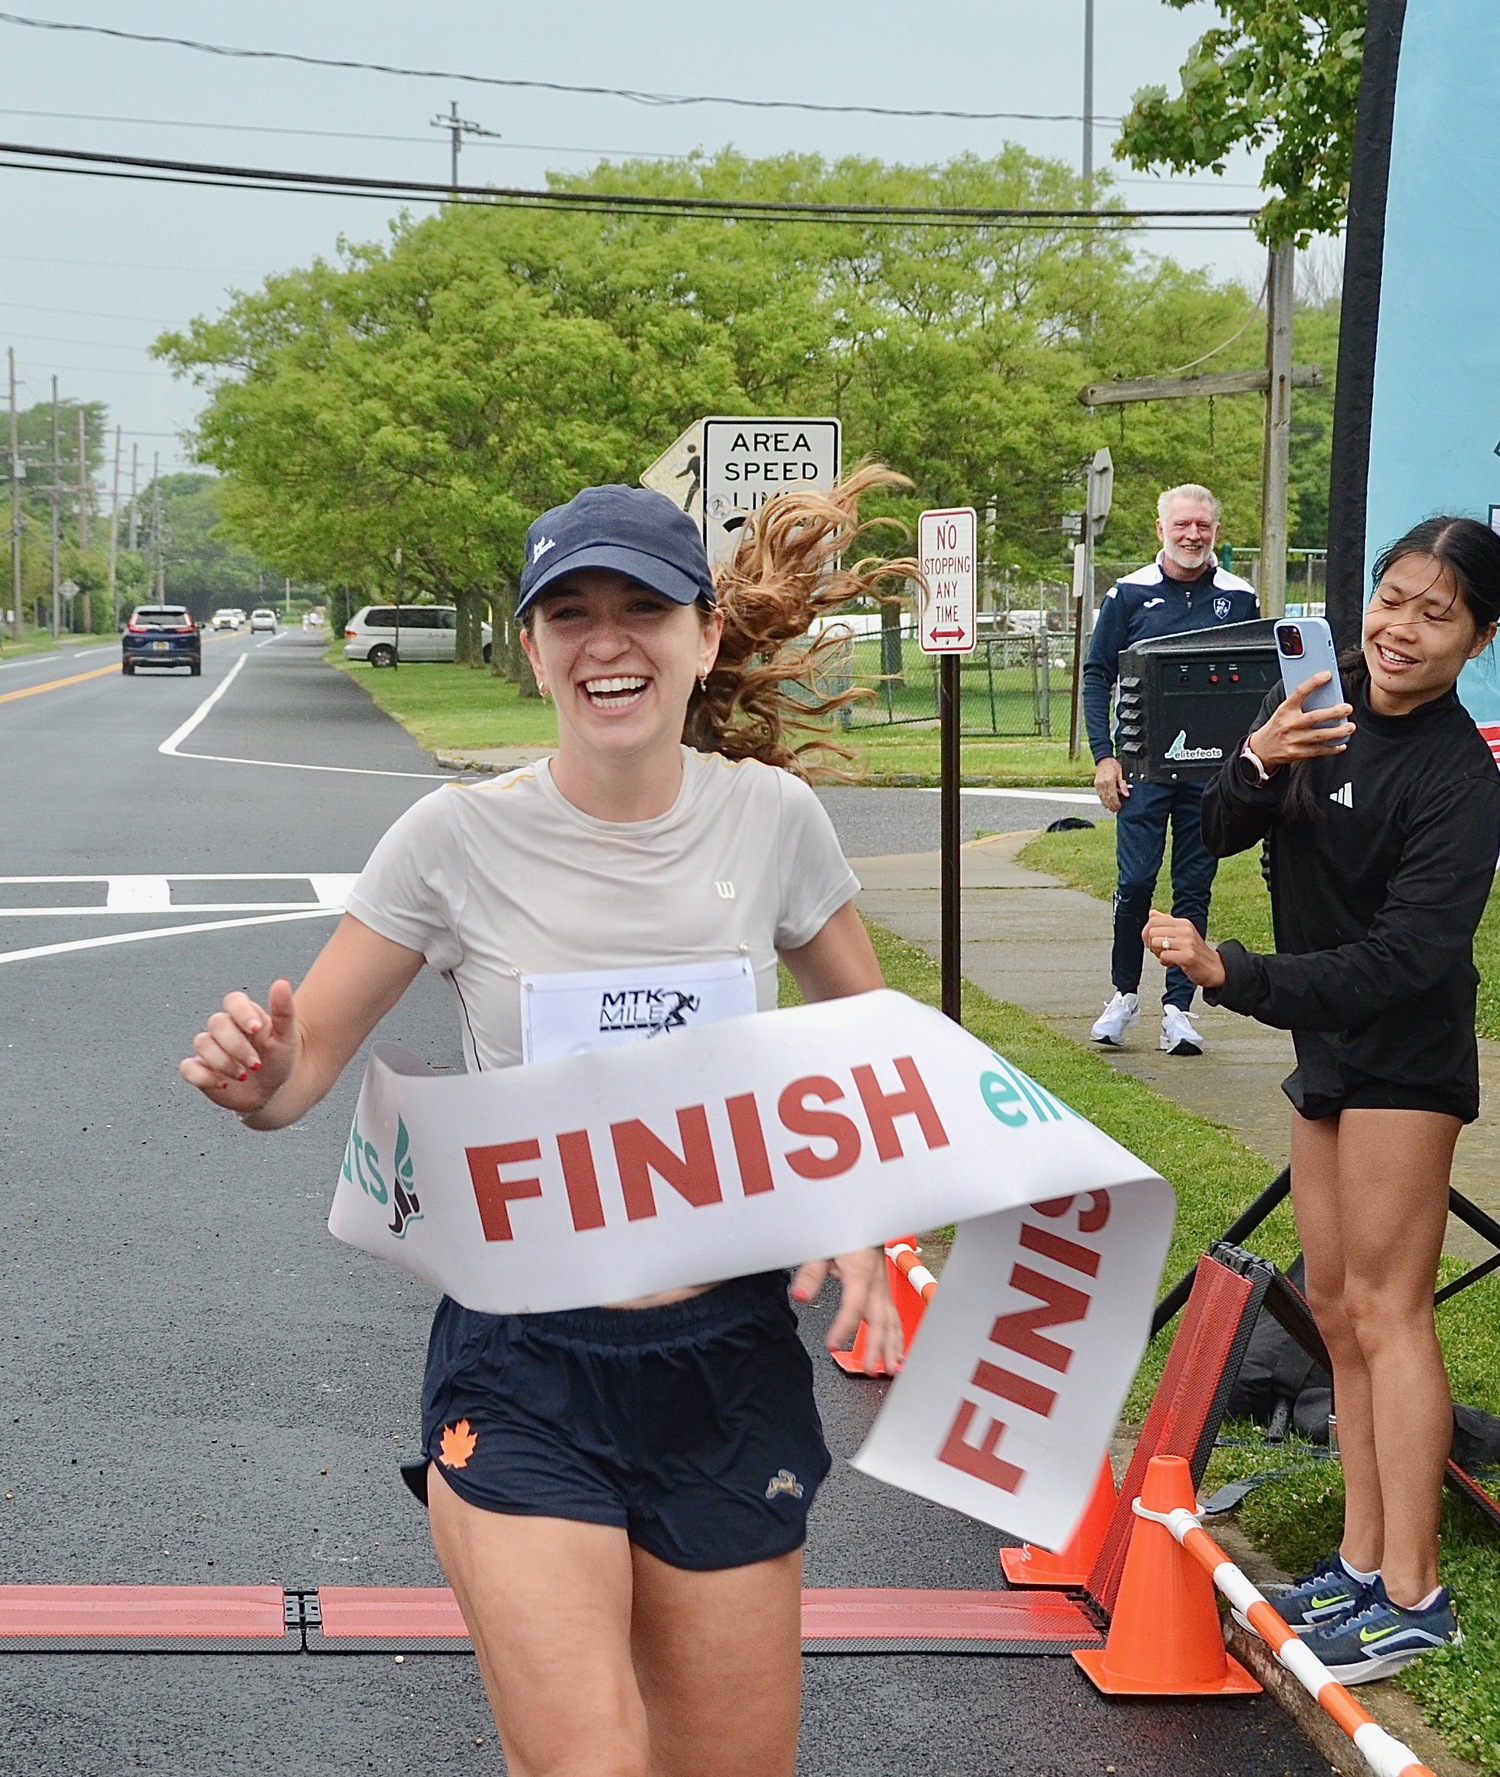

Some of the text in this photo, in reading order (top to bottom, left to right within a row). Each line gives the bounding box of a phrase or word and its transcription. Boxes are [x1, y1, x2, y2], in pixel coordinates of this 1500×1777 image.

[730, 433, 811, 452] AREA
[725, 462, 818, 481] SPEED
[937, 524, 957, 550] NO
[924, 555, 971, 575] STOPPING
[936, 581, 958, 598] ANY
[936, 605, 959, 622] TIME
[1174, 748, 1221, 759] elitefeats
[602, 988, 662, 1006] MTK
[600, 1004, 663, 1023] MILE
[466, 1056, 949, 1242] FINISH
